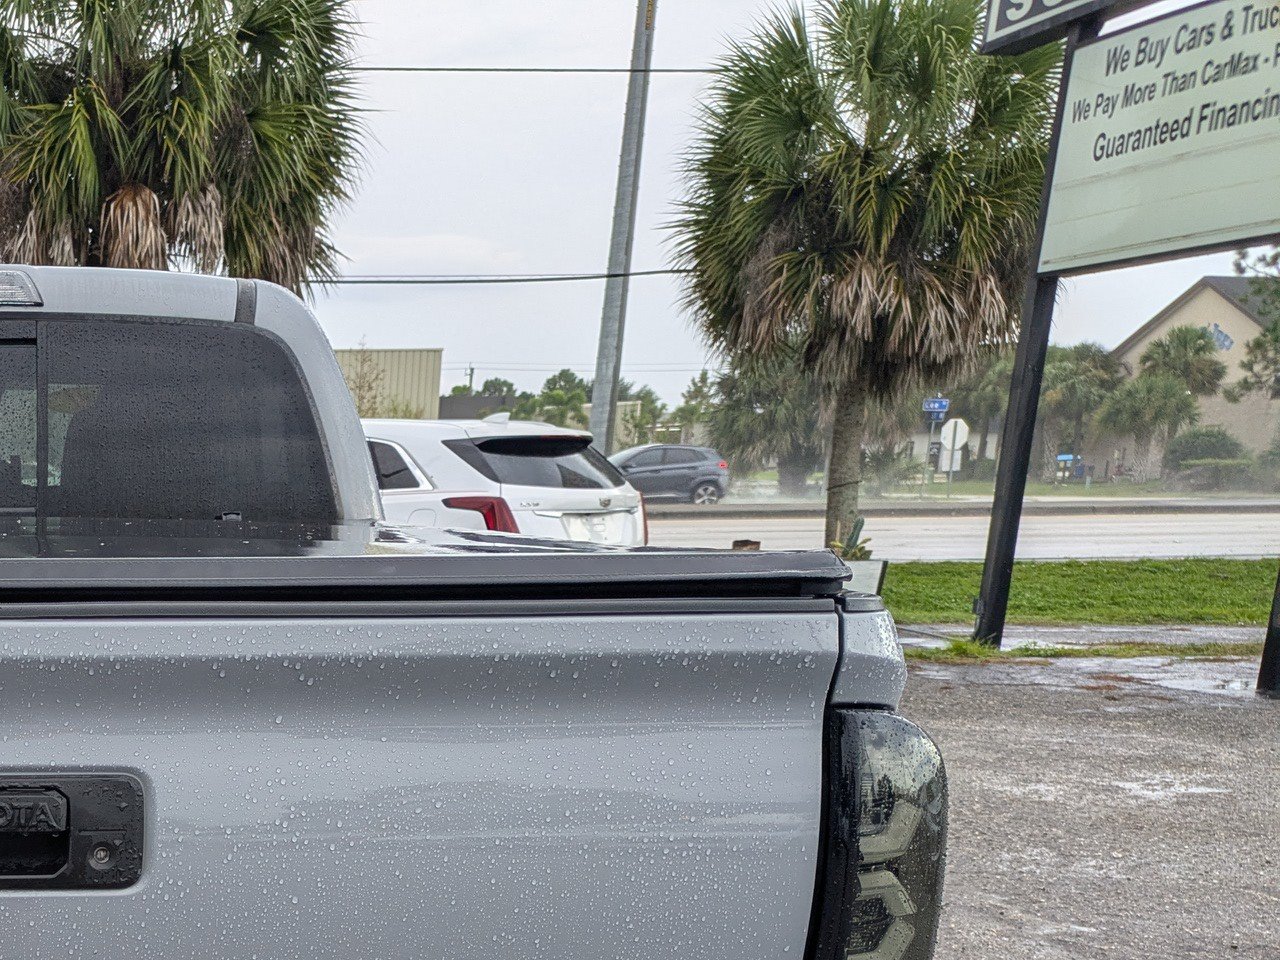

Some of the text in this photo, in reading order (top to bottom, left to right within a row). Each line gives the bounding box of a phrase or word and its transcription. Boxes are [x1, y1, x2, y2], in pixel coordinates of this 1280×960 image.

[1105, 4, 1280, 77] We Buy Cars & Truc
[1072, 98, 1090, 123] We
[1093, 93, 1119, 118] Pay
[1121, 83, 1156, 109] More
[1161, 69, 1197, 97] Than
[1201, 51, 1260, 86] CarMax
[1093, 87, 1280, 161] Guaranteed Financin
